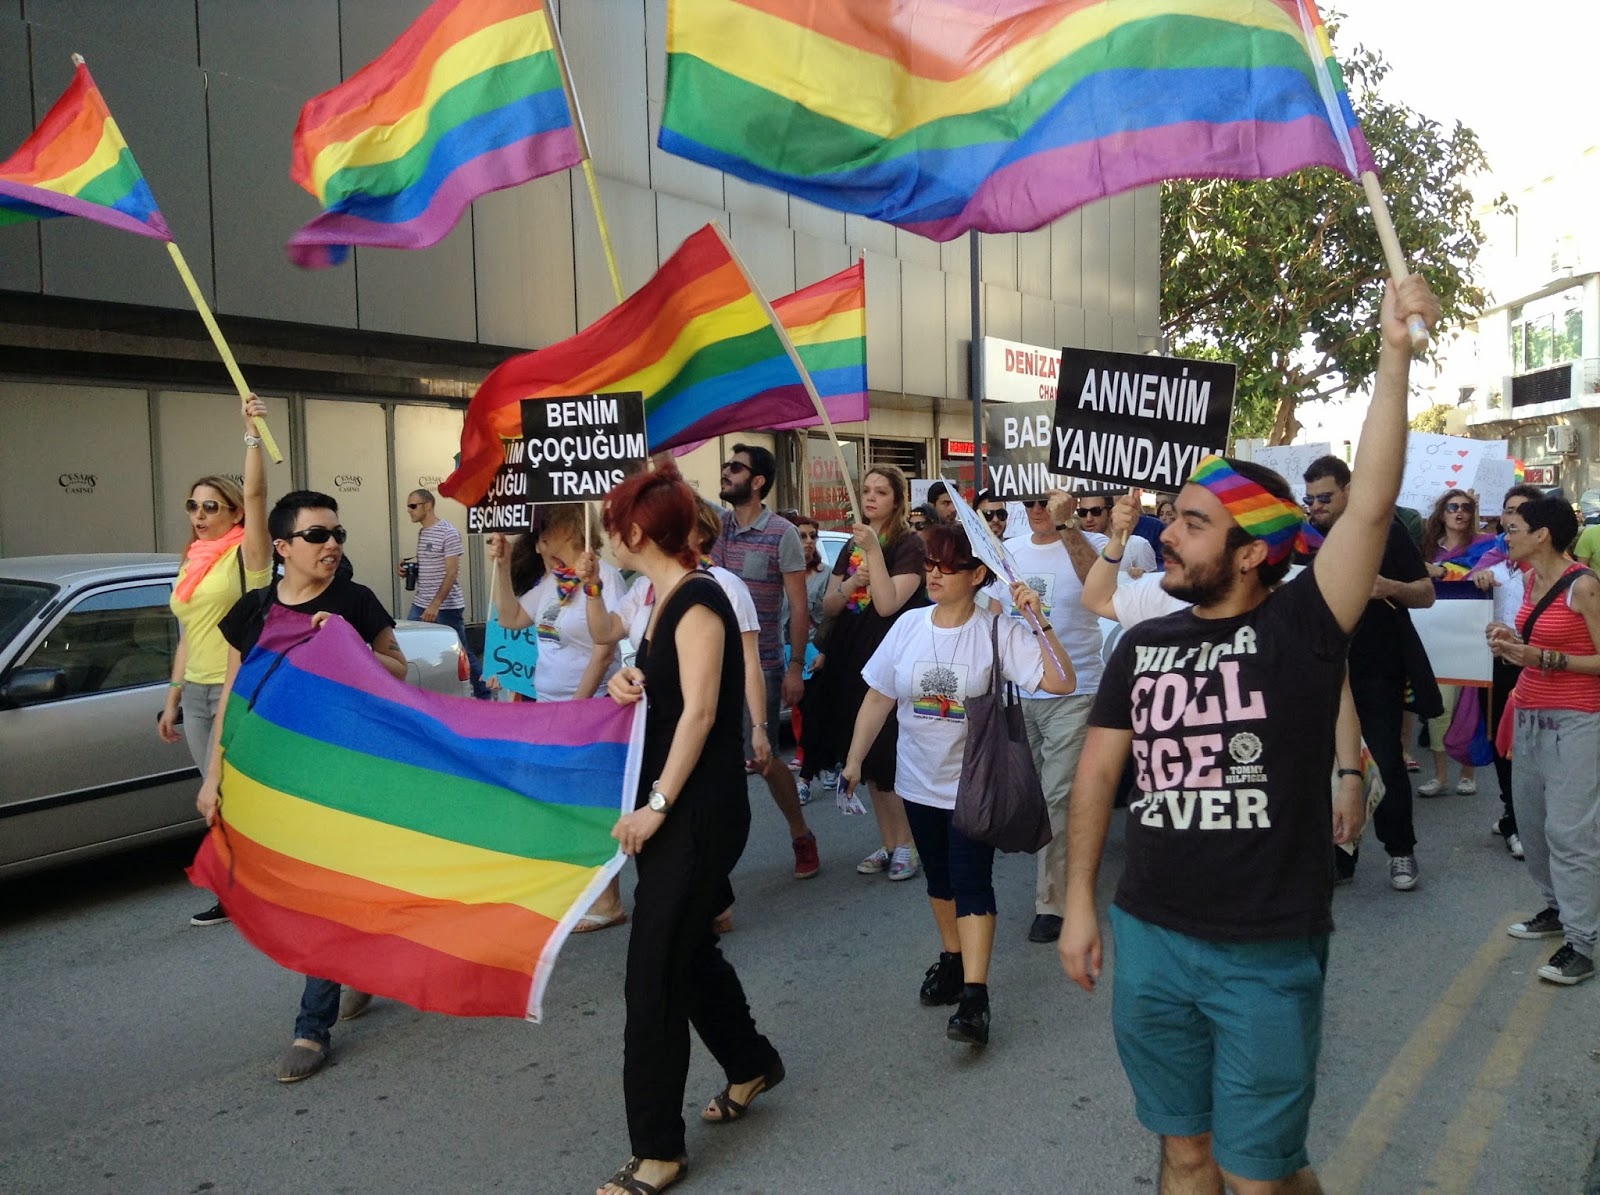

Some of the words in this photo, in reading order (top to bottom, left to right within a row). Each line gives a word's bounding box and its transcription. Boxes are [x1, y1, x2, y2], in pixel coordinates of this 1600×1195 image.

[546, 394, 619, 427] BENİM
[1078, 367, 1211, 425] ANNENİM
[527, 429, 645, 468] ÇOÇUĞUM
[58, 473, 98, 487] CESARS
[334, 475, 363, 487] CESARS
[548, 469, 625, 495] TRANS
[469, 500, 530, 533] EŞCİNSEL
[1131, 661, 1267, 734] COLL
[1132, 733, 1223, 793] EGE
[1225, 773, 1268, 784] HILFIGER
[1229, 765, 1264, 775] TOMMY
